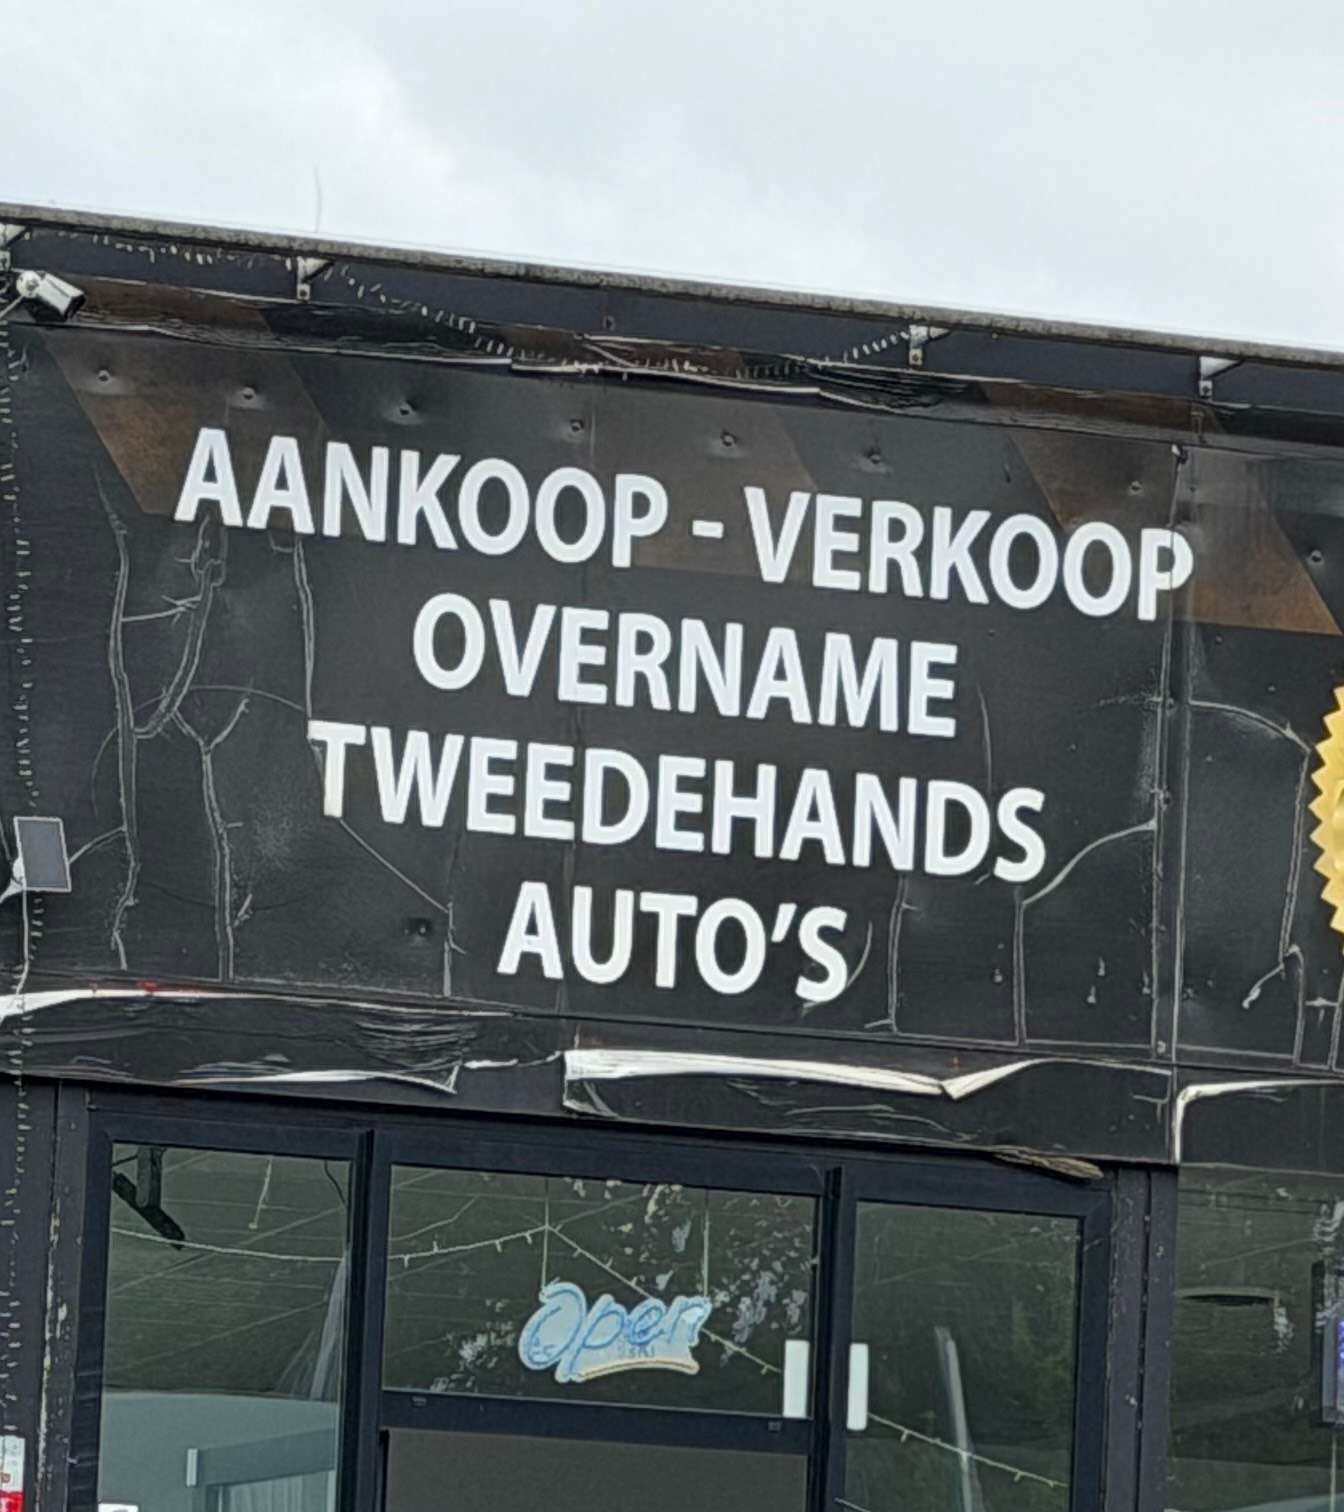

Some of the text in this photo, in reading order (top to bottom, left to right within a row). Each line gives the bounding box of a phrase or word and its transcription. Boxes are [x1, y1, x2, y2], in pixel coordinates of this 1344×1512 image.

[175, 428, 1193, 620] AANKOOP - VERKOOP
[413, 593, 958, 738] OVERNAME
[308, 720, 1046, 883] TWEEDEHANDS
[498, 882, 847, 1002] AUTO'S
[524, 1285, 708, 1378] Open
